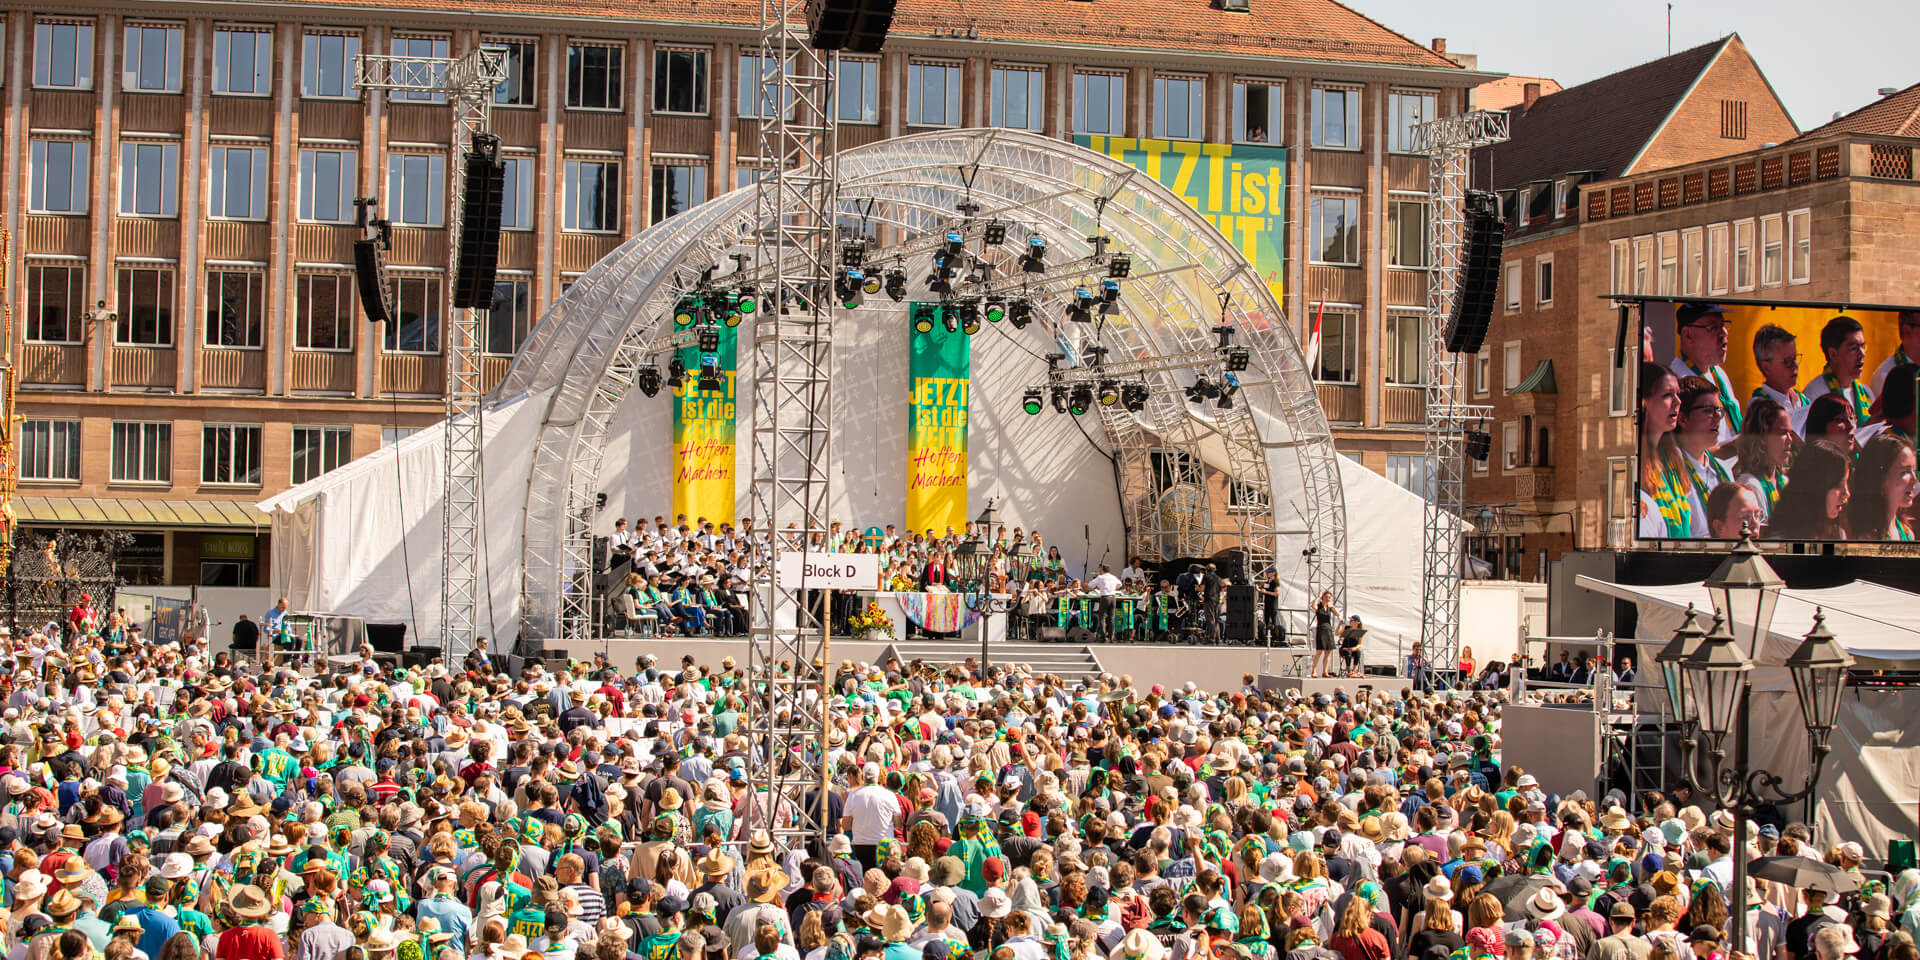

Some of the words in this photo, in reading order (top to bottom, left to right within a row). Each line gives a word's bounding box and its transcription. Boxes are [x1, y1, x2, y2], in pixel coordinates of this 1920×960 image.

[1090, 135, 1232, 213] ETZT
[1230, 162, 1283, 216] ist
[672, 368, 738, 399] JET
[908, 376, 970, 407] JETZT
[681, 397, 704, 419] ist
[706, 398, 735, 420] die
[916, 404, 938, 426] ist
[940, 406, 967, 428] die
[680, 438, 732, 461] Hoffen.
[677, 463, 731, 484] Machen.
[912, 469, 962, 490] Machen.
[804, 564, 841, 578] Block
[846, 565, 856, 578] D
[512, 919, 545, 937] JETZT
